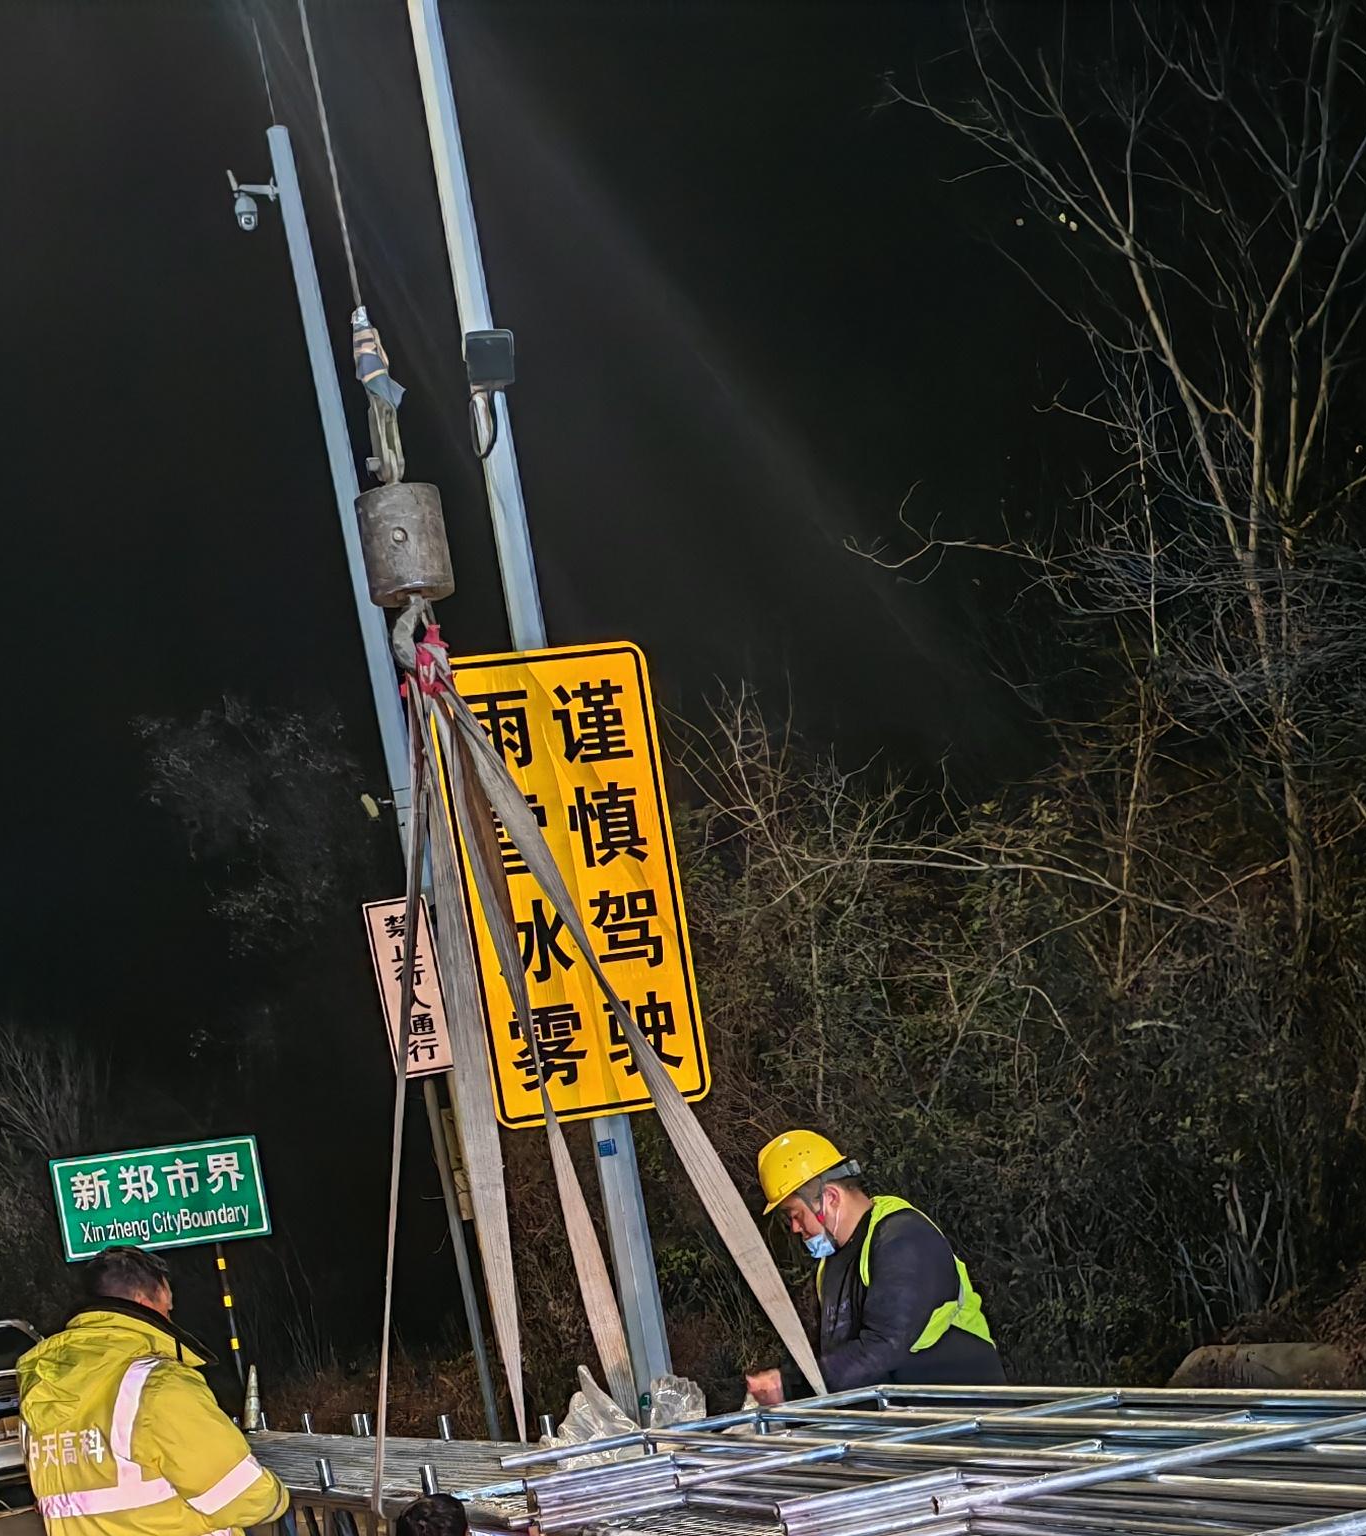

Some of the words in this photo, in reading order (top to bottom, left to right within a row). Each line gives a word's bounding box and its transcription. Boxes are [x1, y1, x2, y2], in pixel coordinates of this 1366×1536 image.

[551, 679, 684, 1077] 谨慎驾驶
[70, 1151, 245, 1211] 新郑市界
